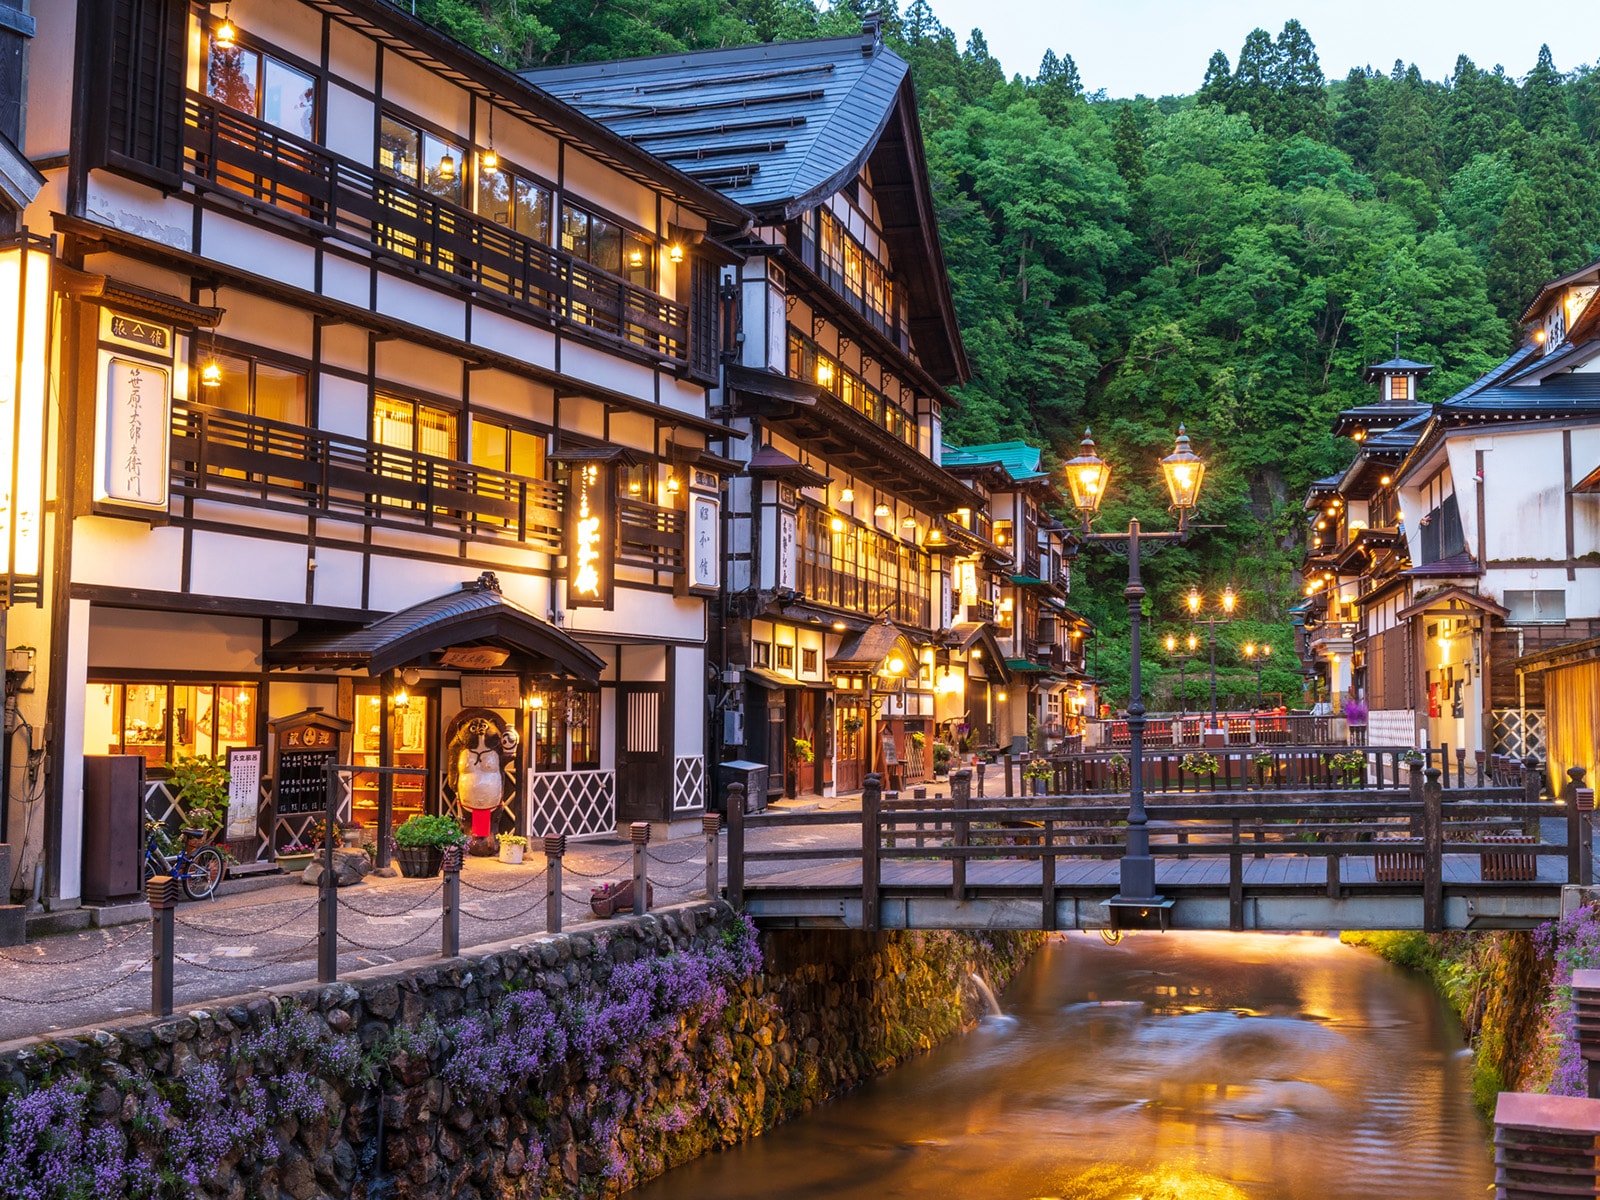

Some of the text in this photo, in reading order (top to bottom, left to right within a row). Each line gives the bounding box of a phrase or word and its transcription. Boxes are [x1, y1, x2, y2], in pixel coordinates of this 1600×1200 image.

[125, 369, 144, 496] 笹原太郎左衛門
[574, 517, 601, 597] 昭和館
[699, 506, 710, 577] 昭和館
